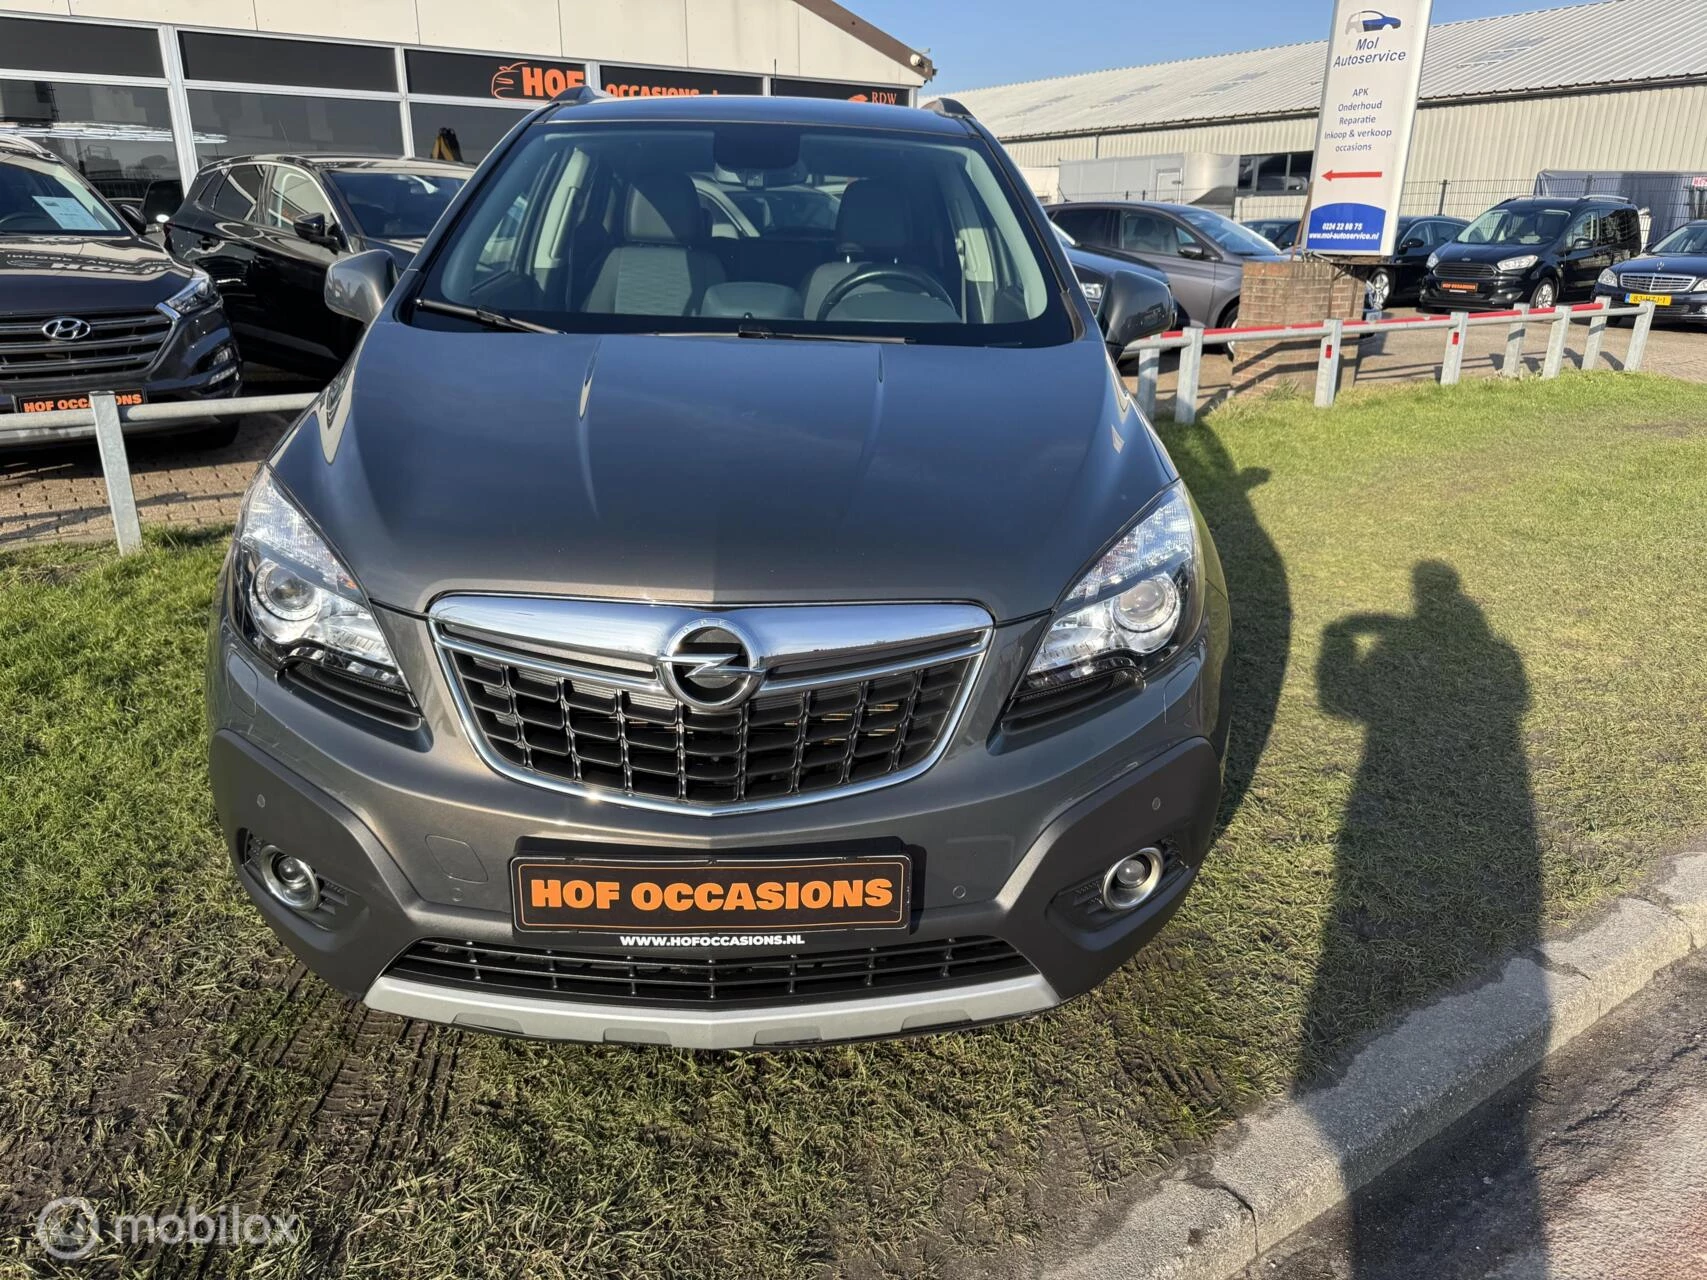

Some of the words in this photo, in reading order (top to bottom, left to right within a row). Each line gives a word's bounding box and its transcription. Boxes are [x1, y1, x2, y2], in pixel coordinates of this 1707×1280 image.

[1355, 37, 1379, 51] Mol
[1333, 50, 1406, 68] Autoservice
[521, 67, 586, 98] HOF
[871, 91, 897, 105] RDW
[1352, 88, 1369, 97] APK
[1338, 101, 1383, 112] Onderhoud
[1339, 115, 1376, 126] Reparatie
[1324, 131, 1347, 140] Inkoop
[1348, 129, 1355, 138] &
[1357, 128, 1392, 139] verkoop
[1335, 143, 1372, 152] occasions
[23, 400, 54, 413] HOF
[57, 394, 142, 409] OCCNS
[531, 878, 620, 909] HOF
[631, 878, 893, 912] OCCASIONS
[620, 934, 805, 947] WWW.HOFOCCASIONS.NL
